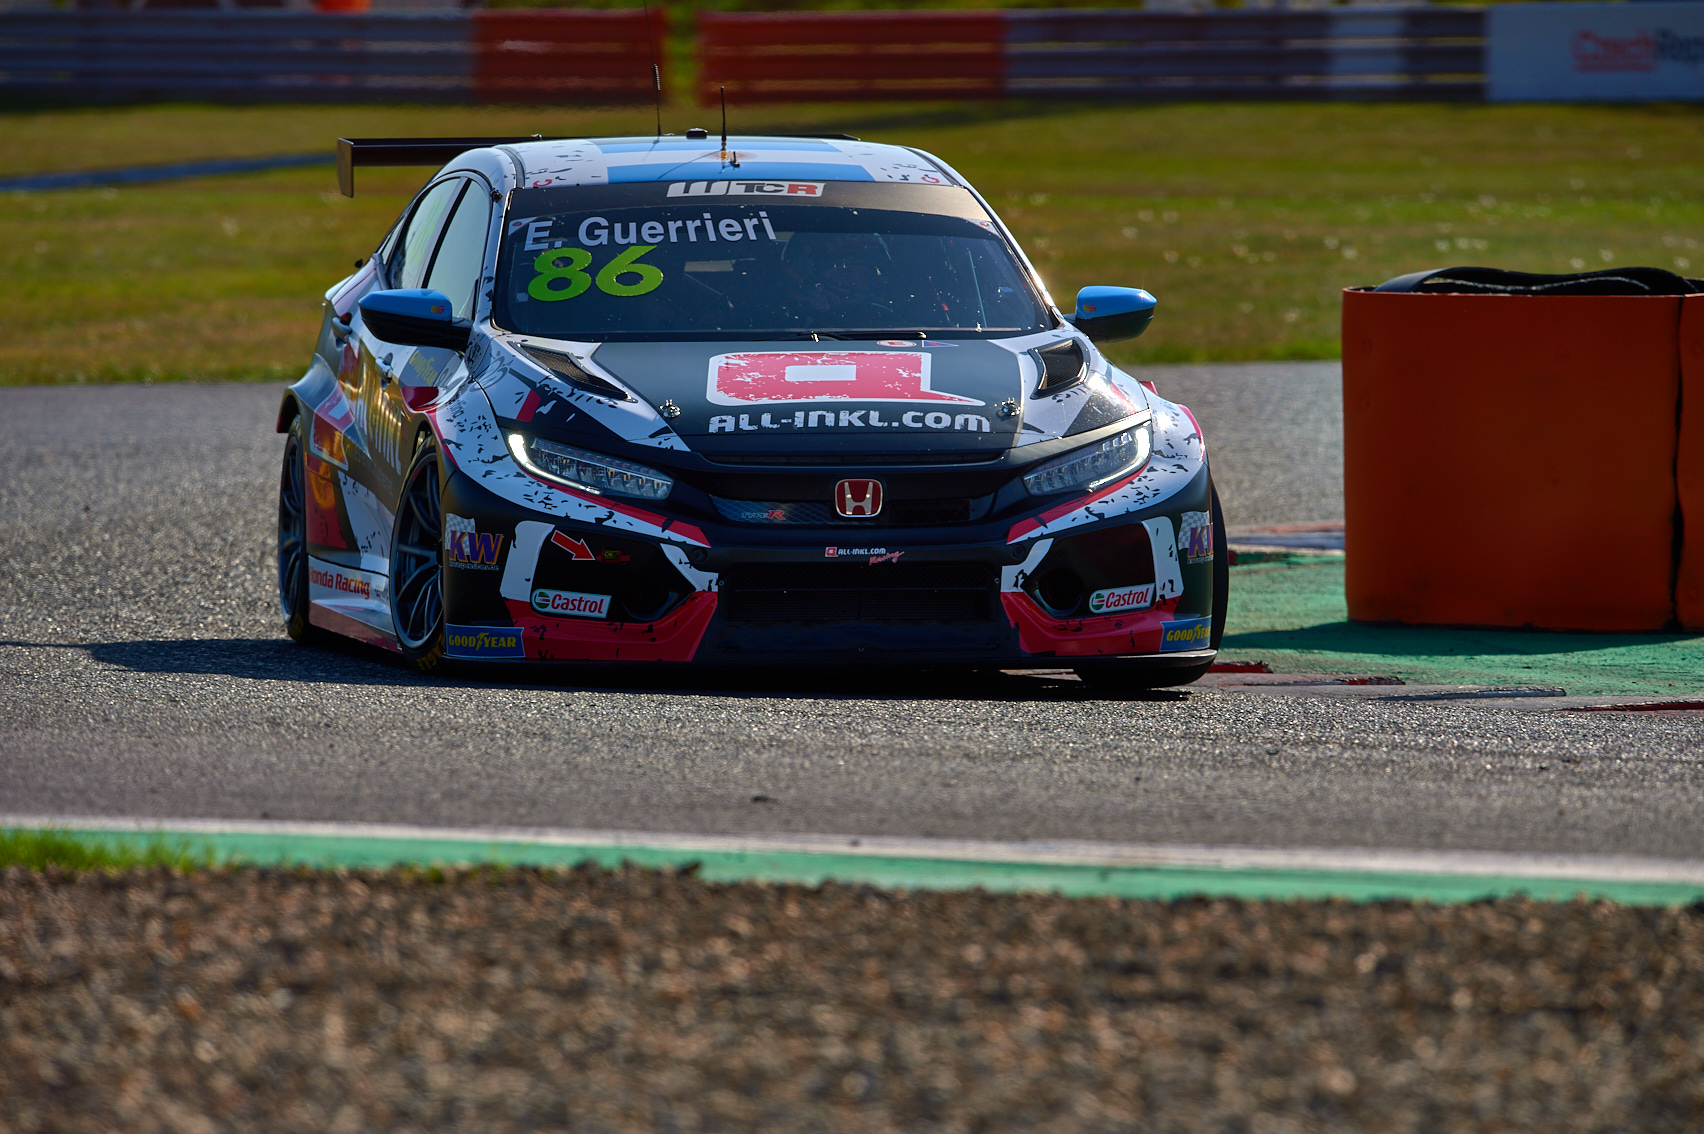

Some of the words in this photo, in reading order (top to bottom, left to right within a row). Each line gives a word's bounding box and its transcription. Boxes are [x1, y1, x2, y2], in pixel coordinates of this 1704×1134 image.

[666, 180, 827, 198] WTCR
[524, 220, 563, 251] E.
[577, 210, 777, 247] Guerrieri
[527, 244, 664, 302] 86
[450, 529, 505, 564] KW
[335, 573, 370, 600] Racing
[1105, 587, 1150, 609] Castrol
[551, 593, 605, 614] Castrol
[448, 632, 517, 651] GOODYEAR
